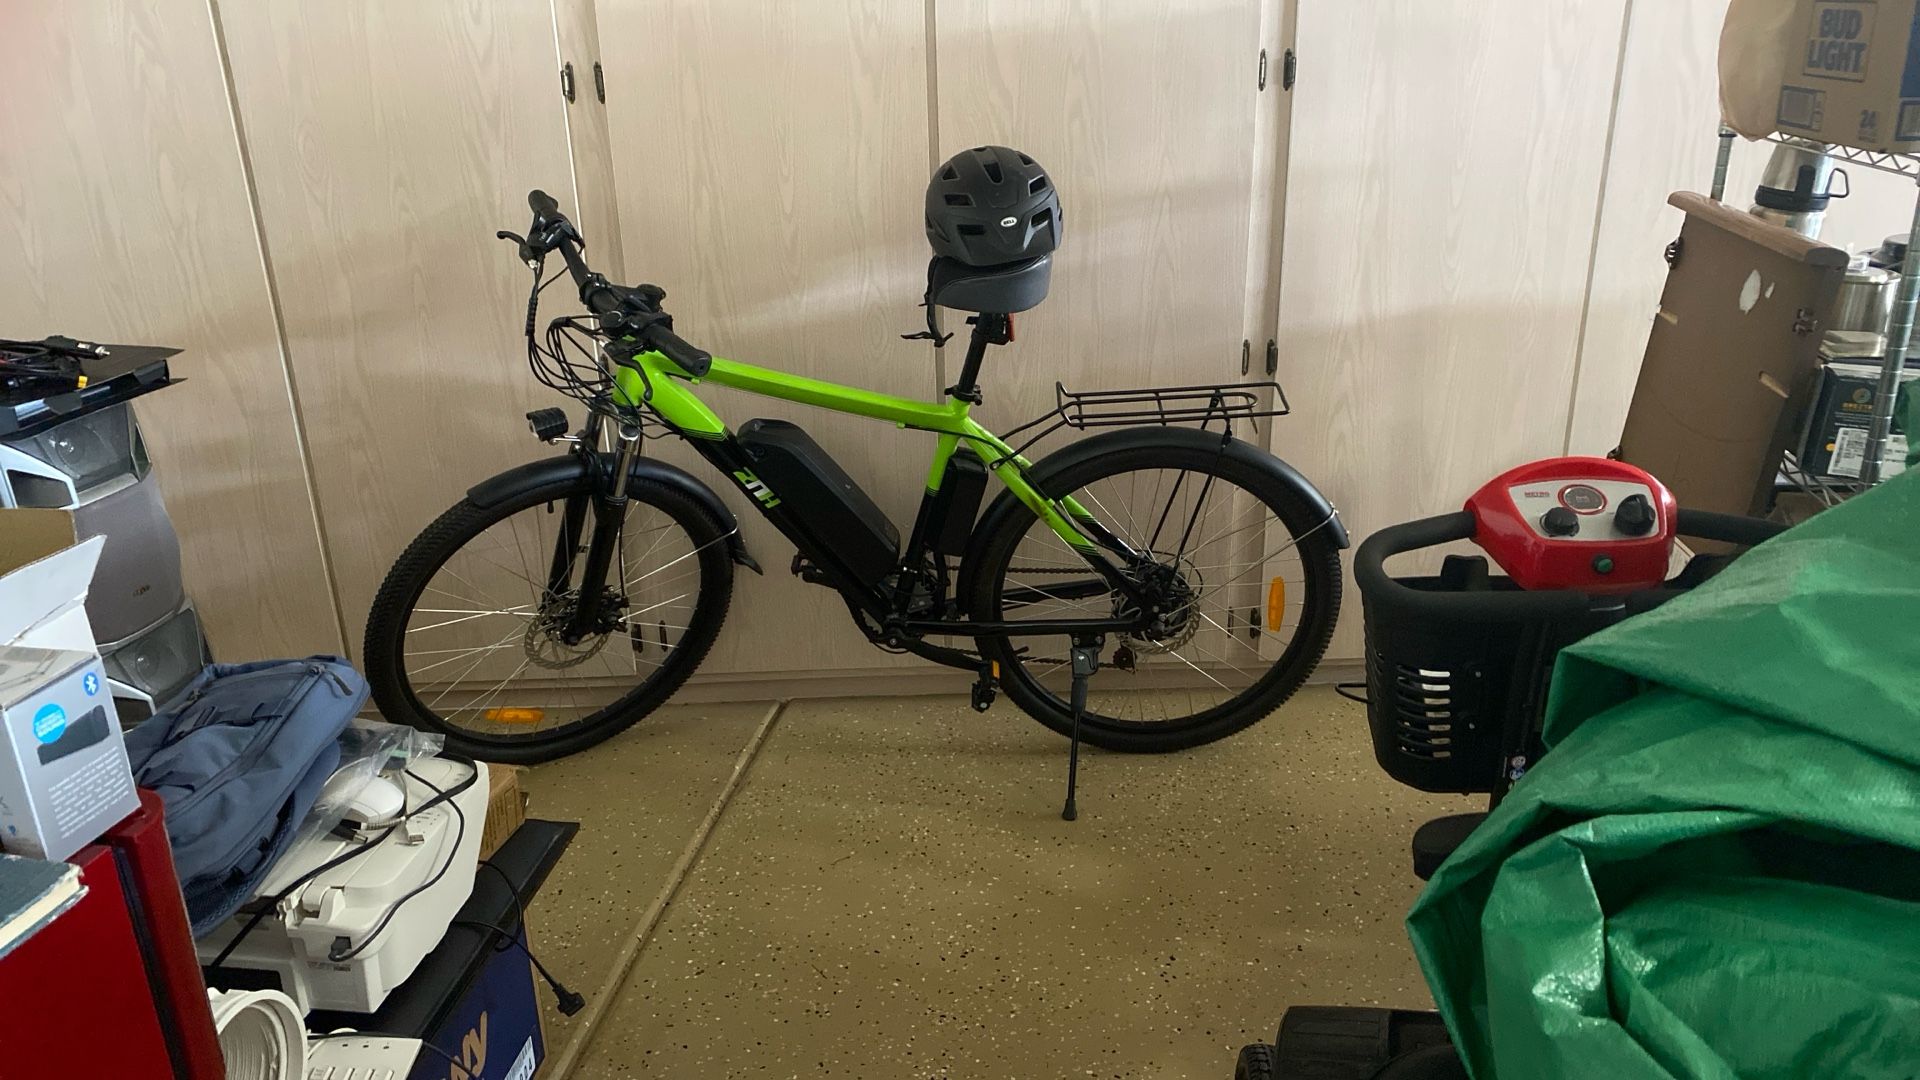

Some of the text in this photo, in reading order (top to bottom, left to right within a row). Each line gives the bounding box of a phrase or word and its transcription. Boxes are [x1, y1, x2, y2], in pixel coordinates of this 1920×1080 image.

[1820, 8, 1863, 40] BUD
[1807, 40, 1868, 73] LIGHT
[1859, 109, 1877, 129] 24
